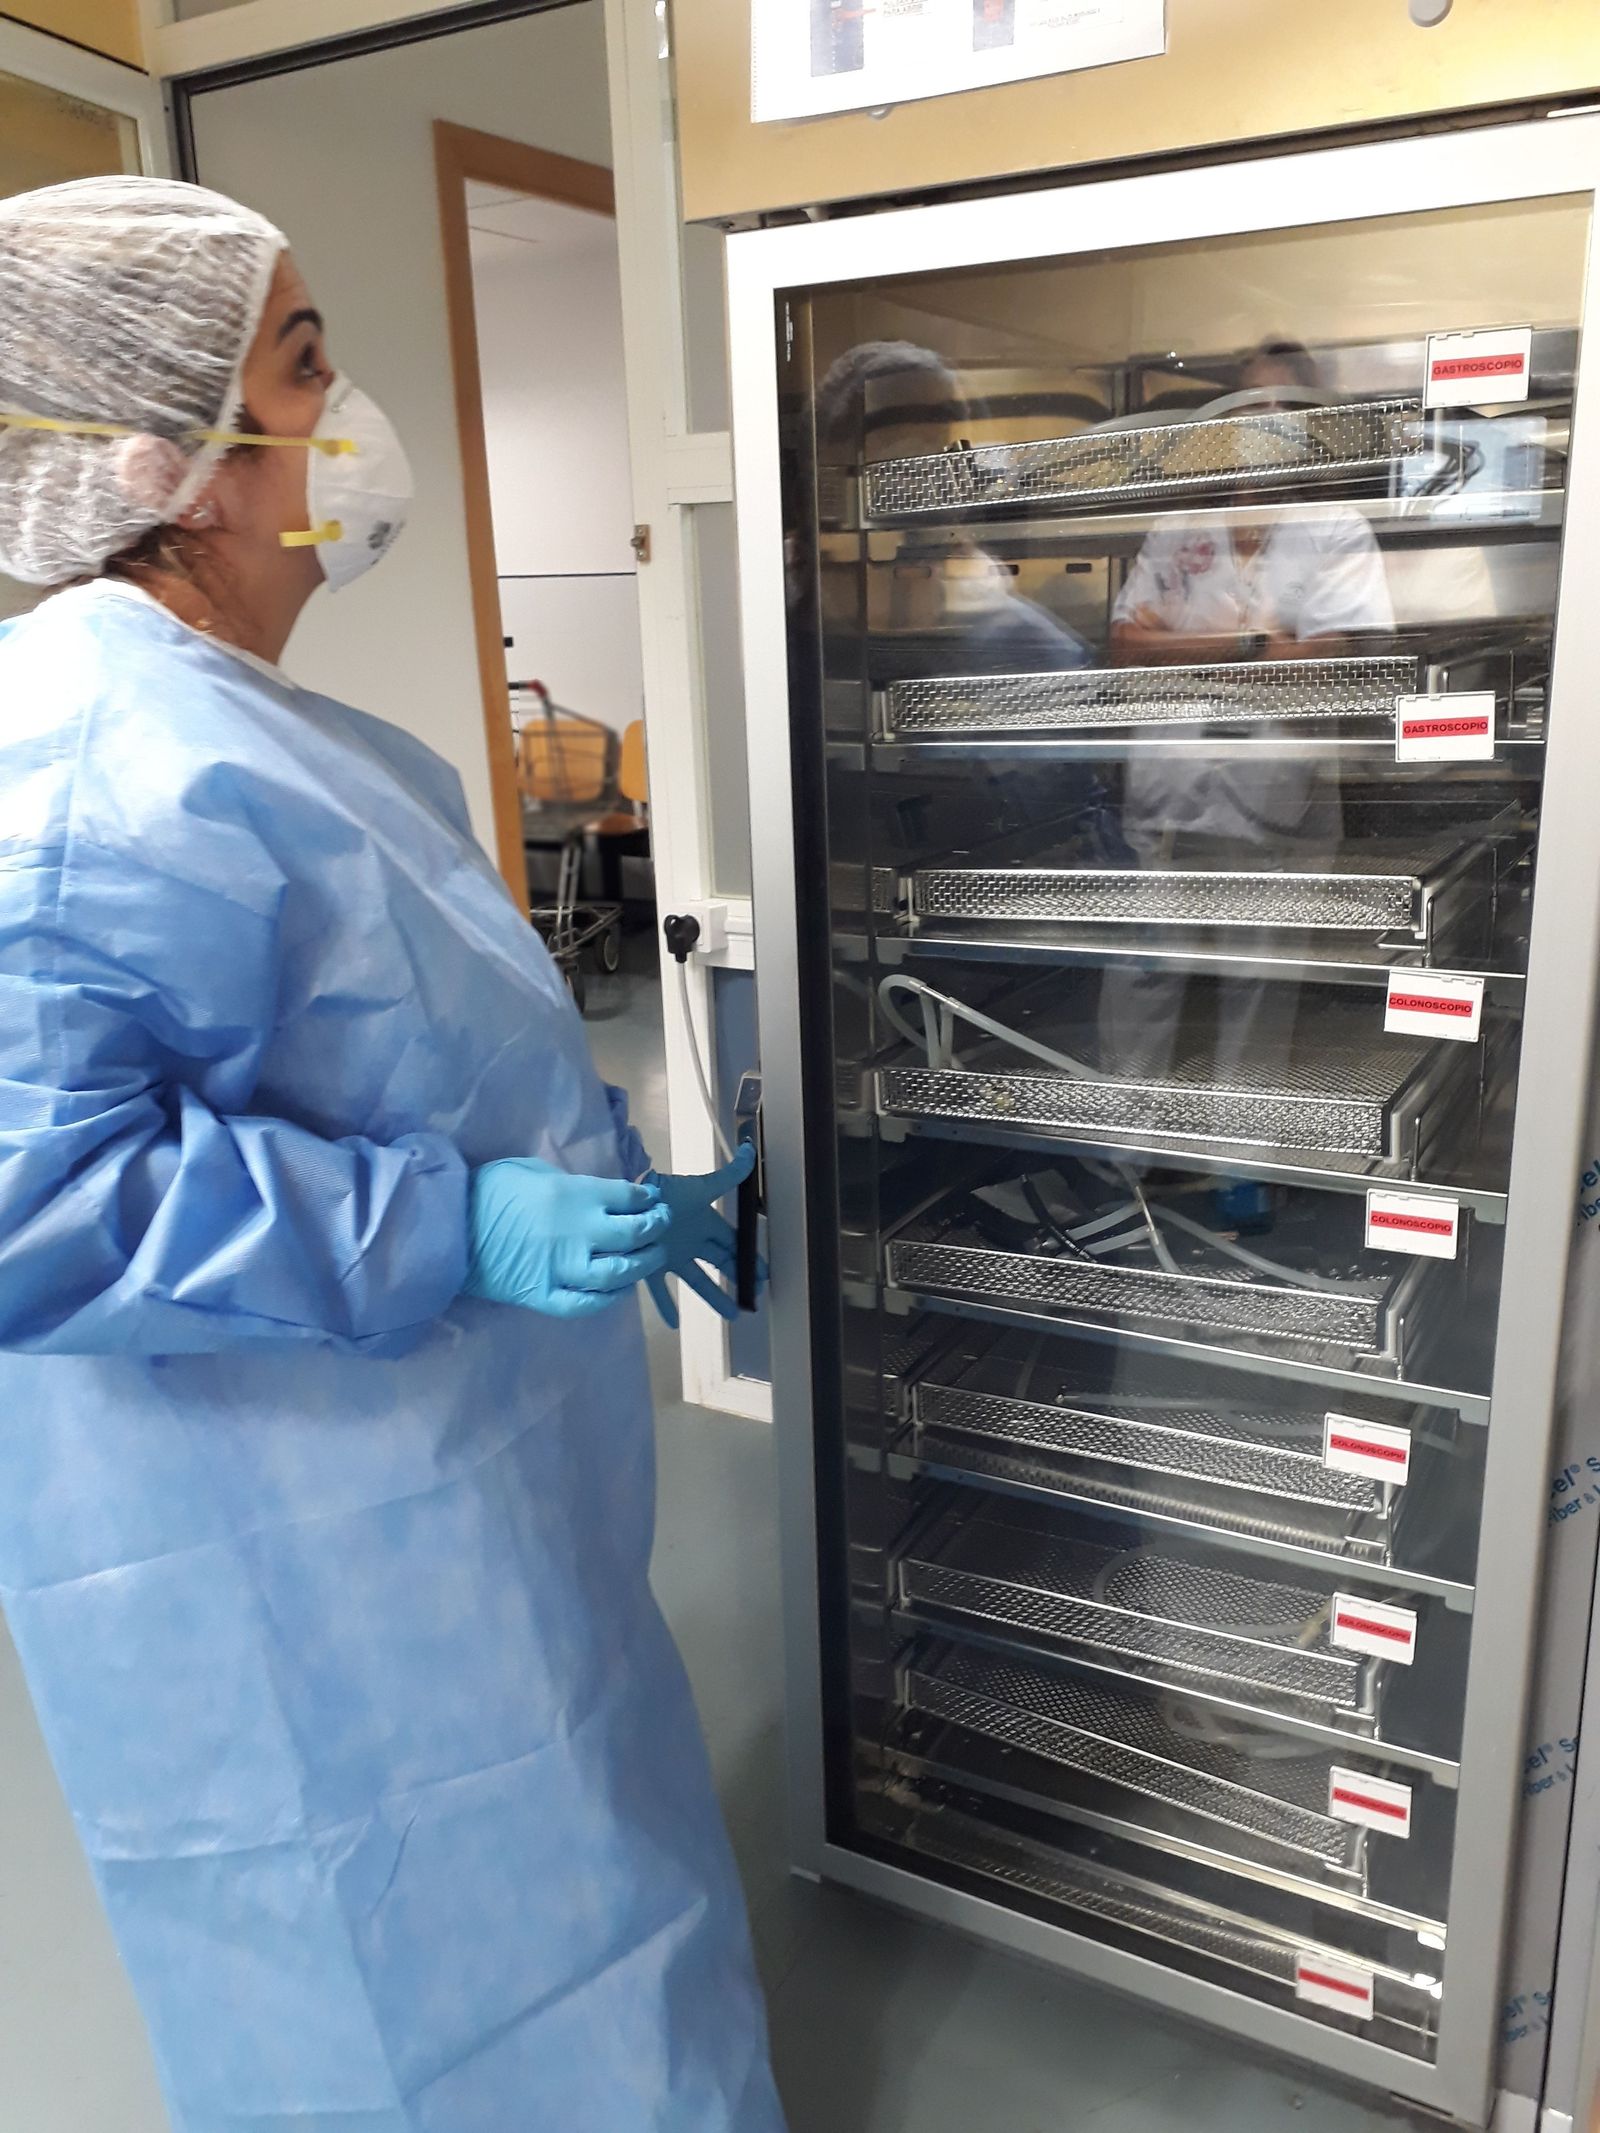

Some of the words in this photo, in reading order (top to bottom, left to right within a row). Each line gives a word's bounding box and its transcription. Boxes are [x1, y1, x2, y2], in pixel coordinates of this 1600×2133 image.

[1433, 359, 1522, 375] GASTROSCOPIO
[1403, 721, 1488, 734] GASTROSCOPIO
[1389, 997, 1472, 1013] COLONOSCOPIO
[1371, 1215, 1452, 1232] COLONOSCOPIO
